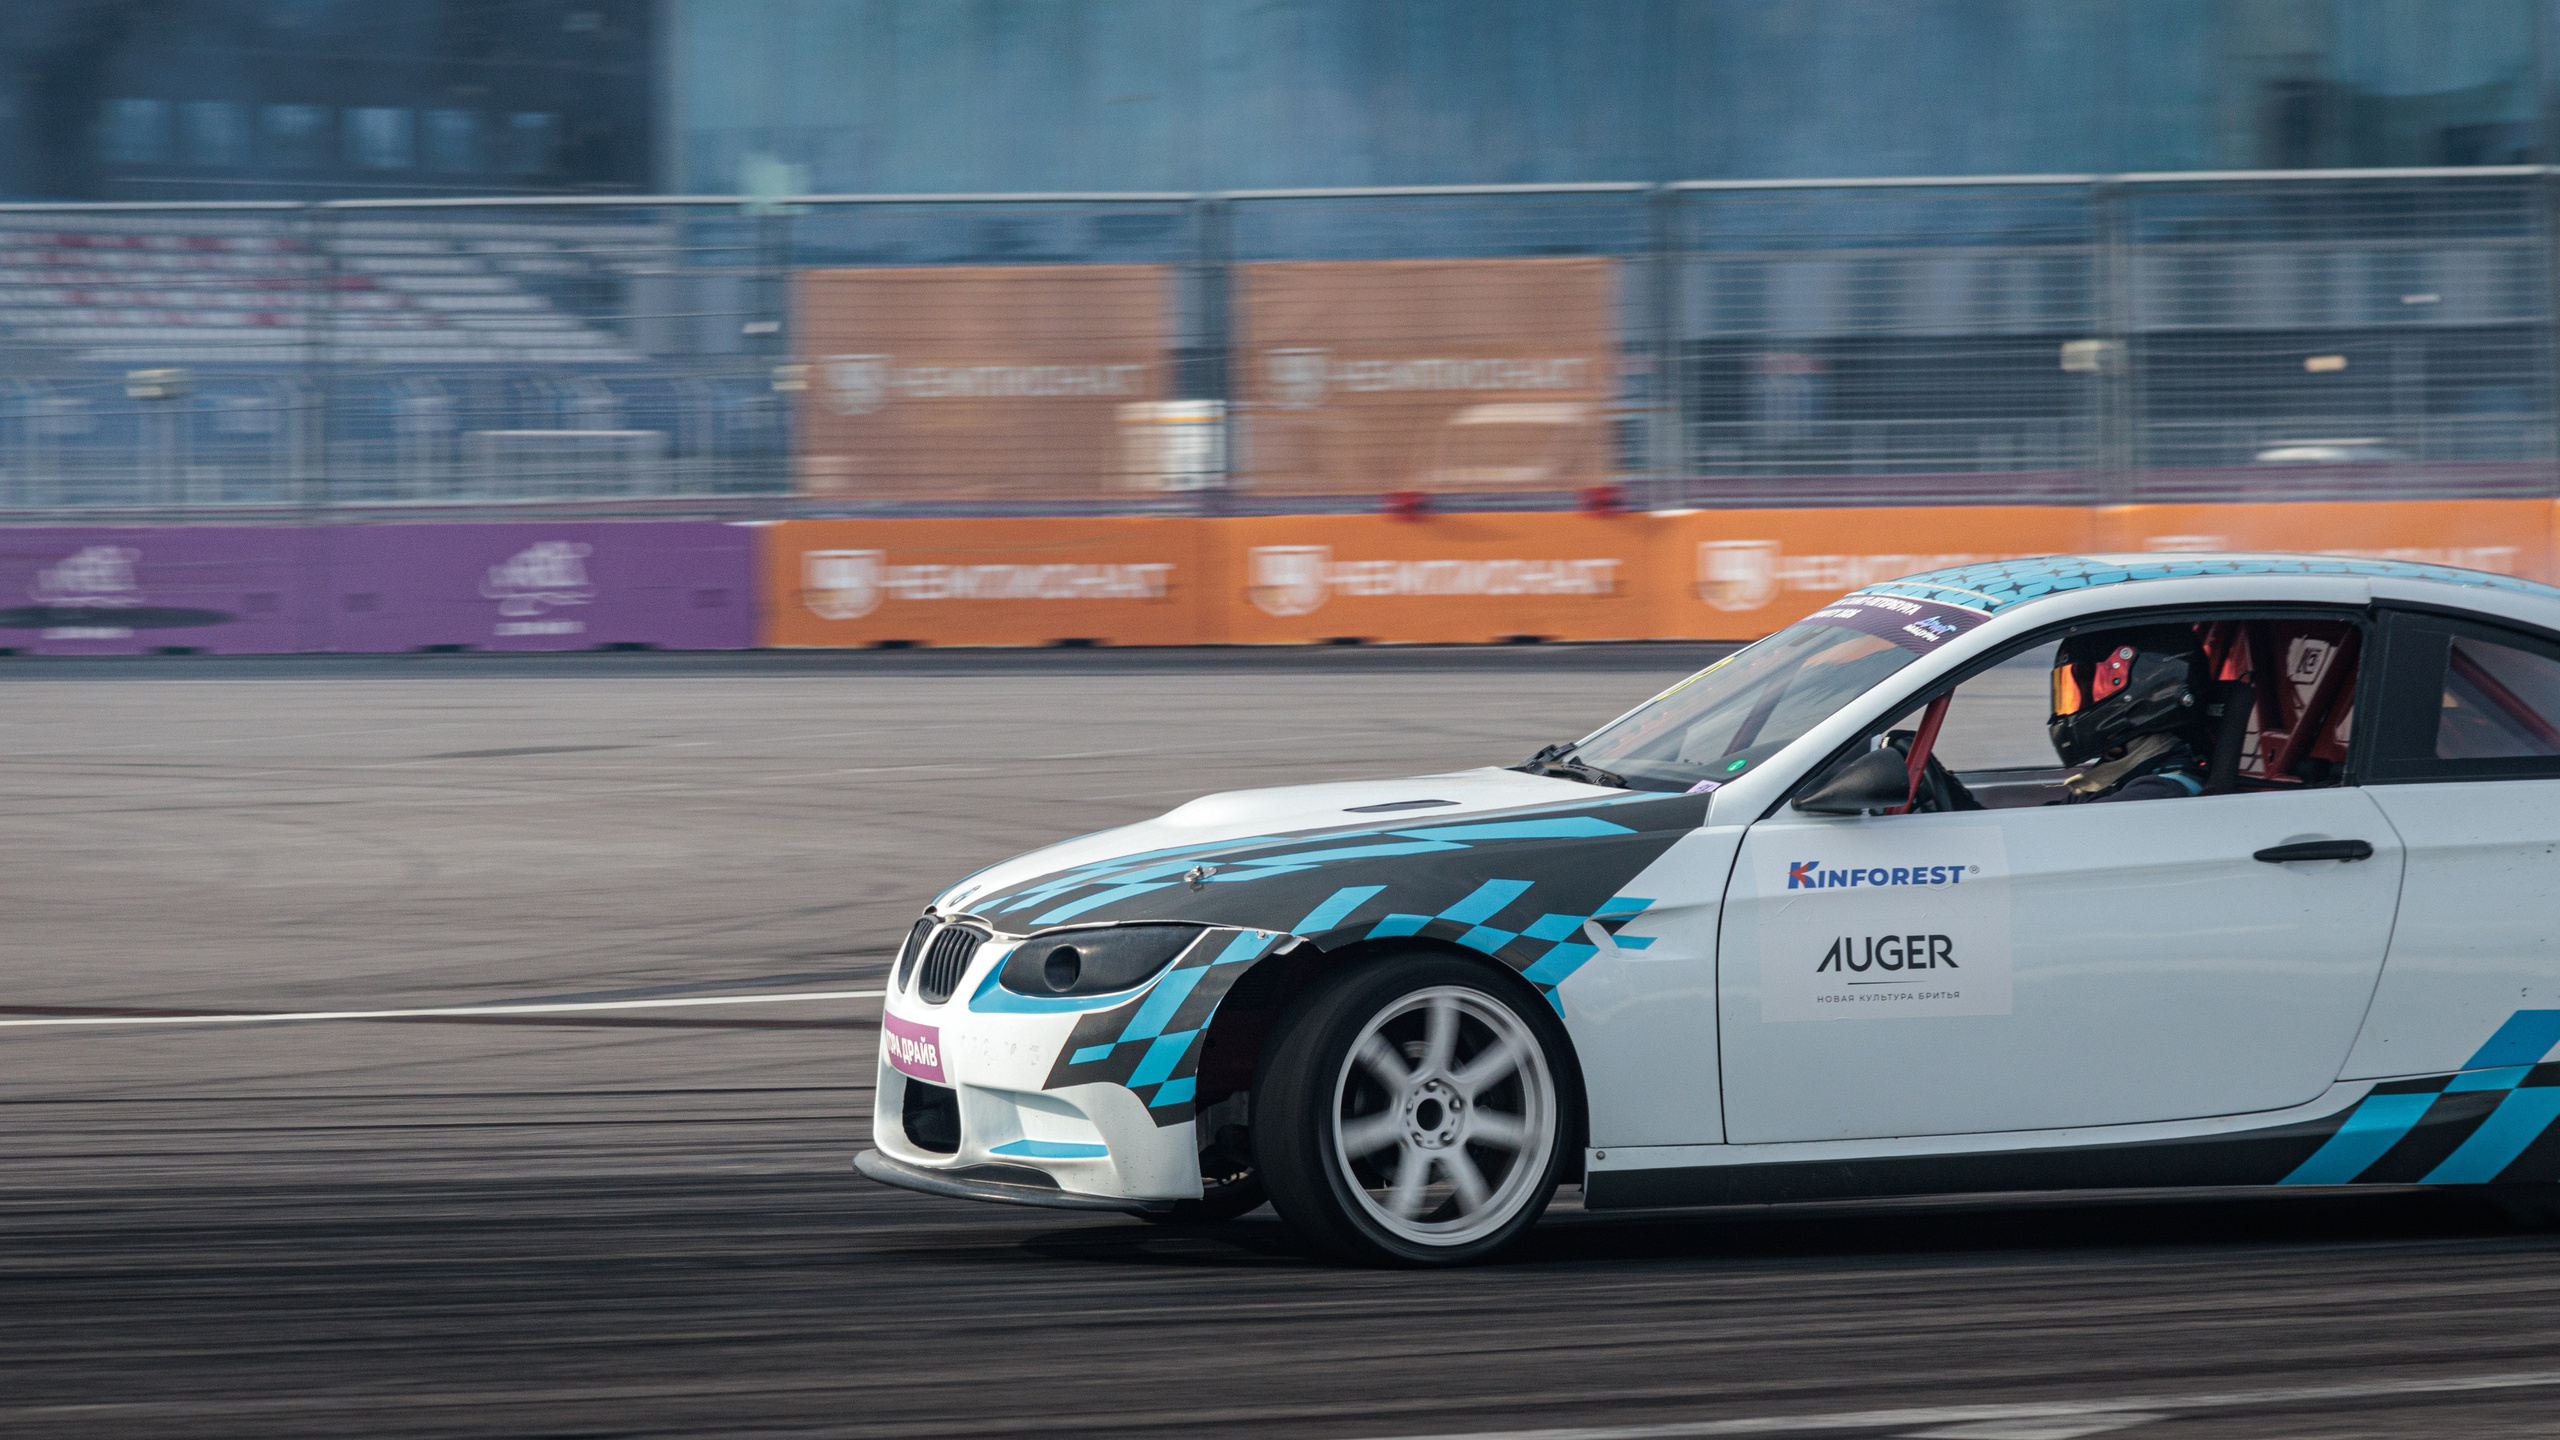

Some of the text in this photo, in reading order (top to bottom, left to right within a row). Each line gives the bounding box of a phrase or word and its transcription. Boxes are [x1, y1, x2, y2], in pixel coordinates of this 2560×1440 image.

[1816, 934, 1960, 972] AUGER
[1817, 991, 1960, 1003] НОВАЯ КУЛЬТУРА БРИТЬЯ
[901, 1036, 938, 1067] ДРАЙВ
